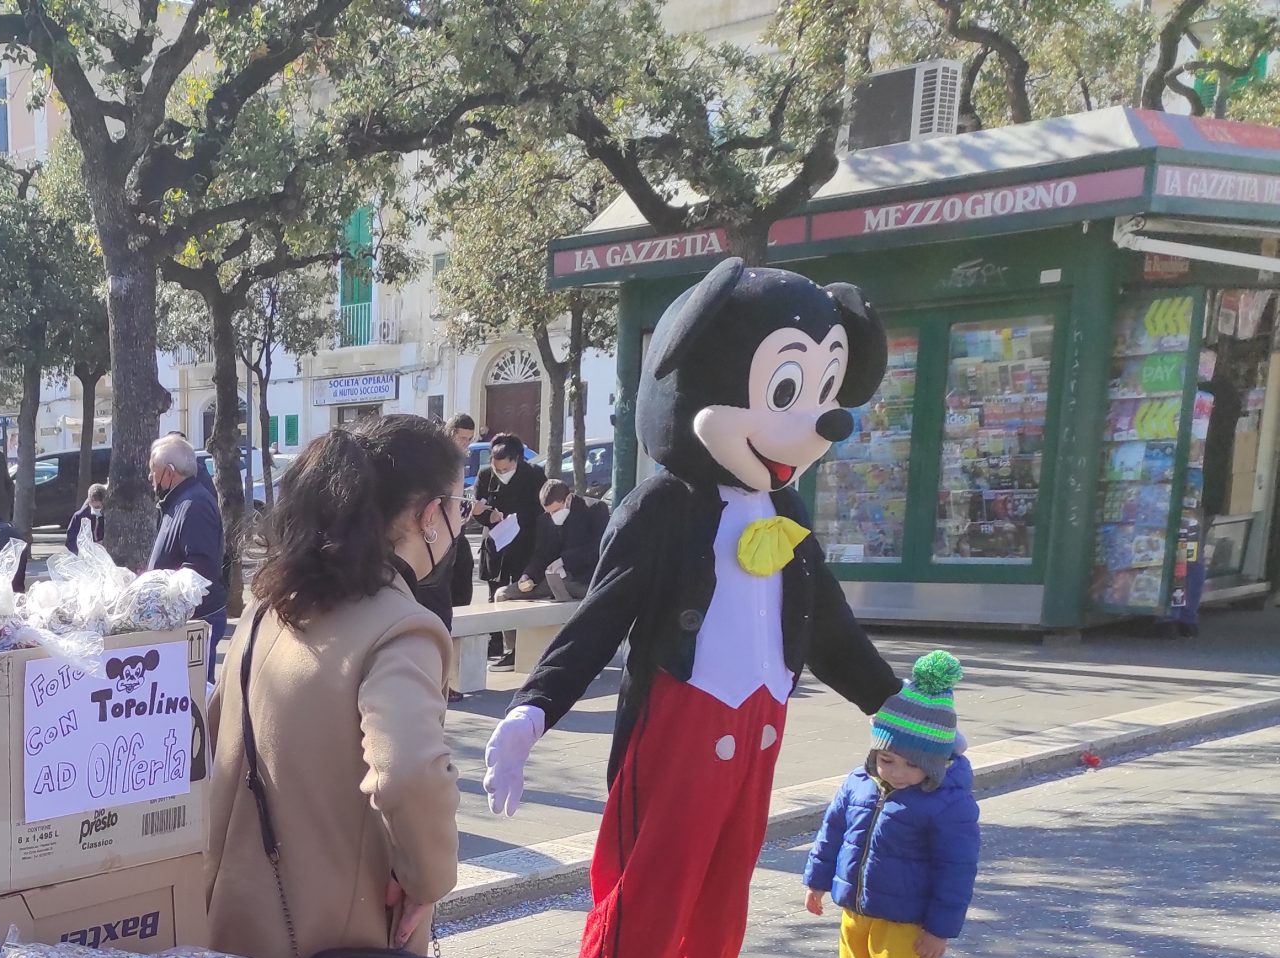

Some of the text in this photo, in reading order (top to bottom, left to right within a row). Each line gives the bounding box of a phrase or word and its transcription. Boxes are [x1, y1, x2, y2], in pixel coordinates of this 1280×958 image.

[1164, 170, 1182, 196] LA
[1188, 173, 1258, 203] GAZZETTA
[863, 180, 1077, 233] MEZZOGIORNO
[574, 232, 723, 272] LA GAZZETTA
[339, 387, 359, 397] MUTUO
[359, 385, 390, 396] SOCCORSO
[362, 374, 394, 386] OPERAIA
[33, 762, 78, 795] AD
[81, 838, 113, 851] Classico
